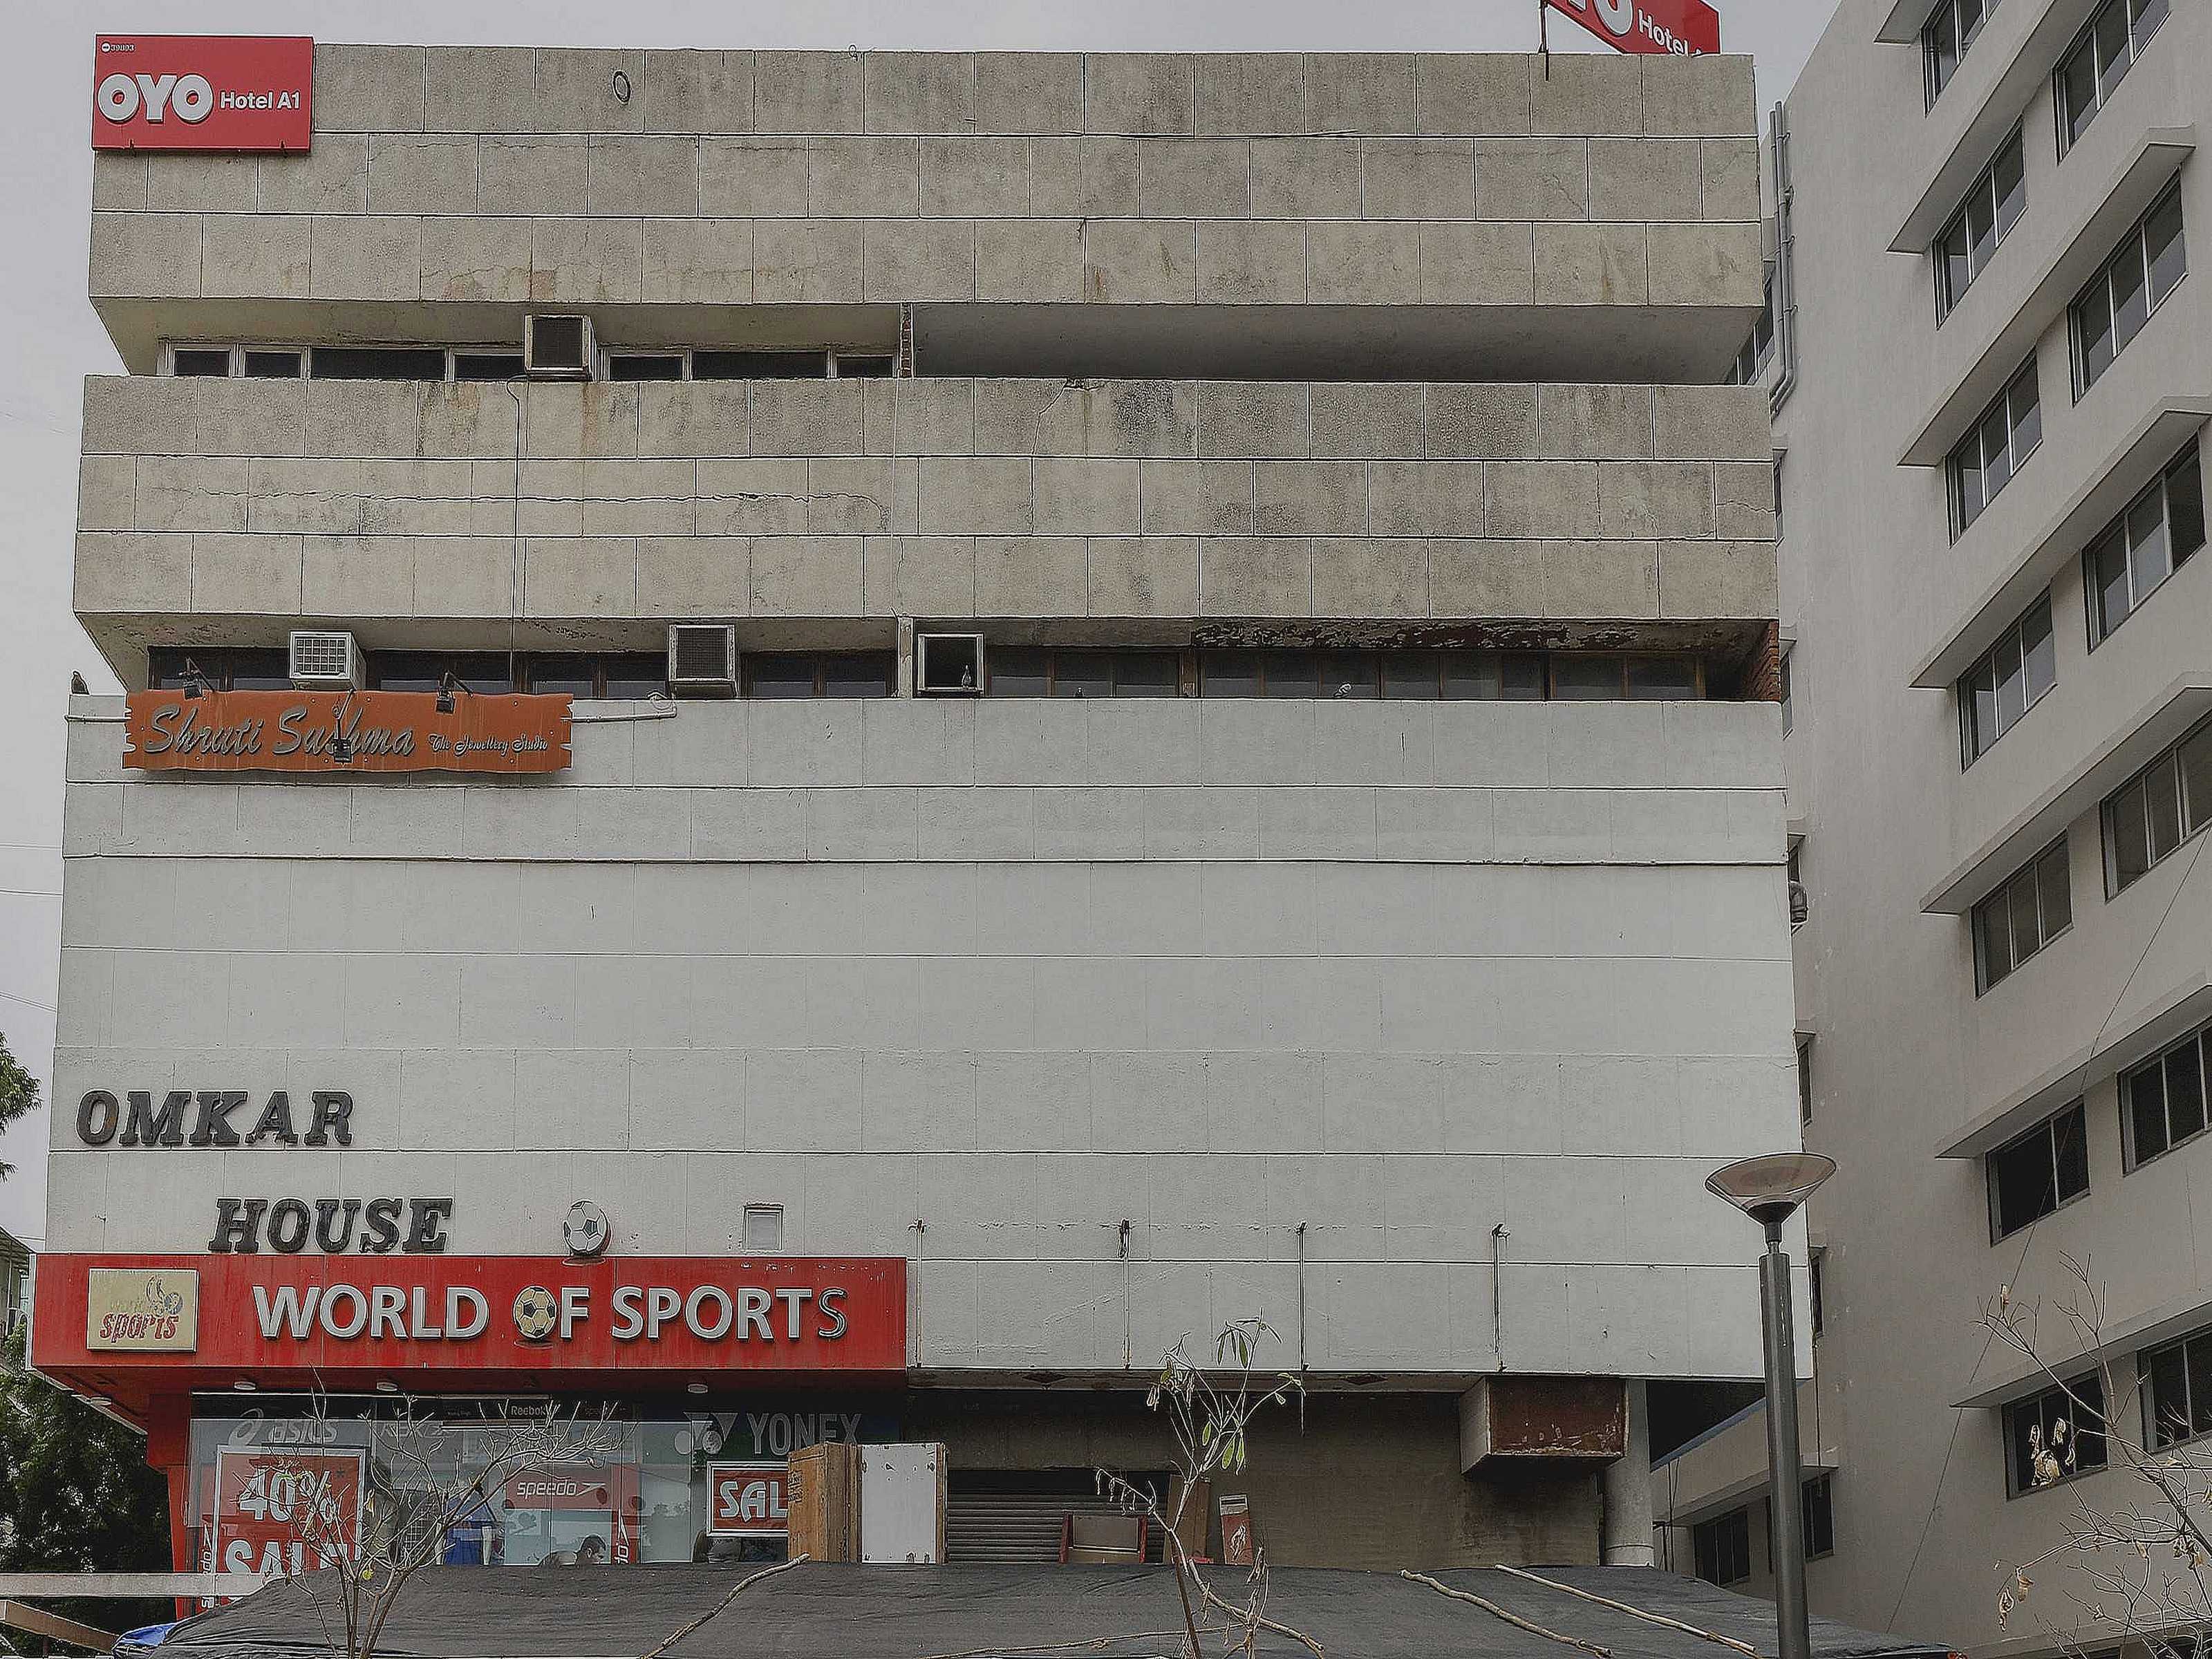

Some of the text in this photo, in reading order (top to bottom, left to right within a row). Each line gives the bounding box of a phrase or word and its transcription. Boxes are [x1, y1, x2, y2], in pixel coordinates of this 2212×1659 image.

[1638, 8, 1689, 56] Hotel
[97, 73, 299, 122] OYO Hotel A1
[143, 704, 265, 755] Shruti
[428, 733, 451, 752] The
[453, 734, 509, 757] Jewellery
[512, 733, 548, 752] Studio
[75, 1090, 354, 1146] OMKAR
[208, 1197, 453, 1253] HOUSE
[252, 1284, 489, 1339] WORLD
[611, 1285, 848, 1340] SPORTS
[747, 1412, 862, 1456] YONEX
[516, 1479, 577, 1499] speedo
[718, 1480, 788, 1524] SAL
